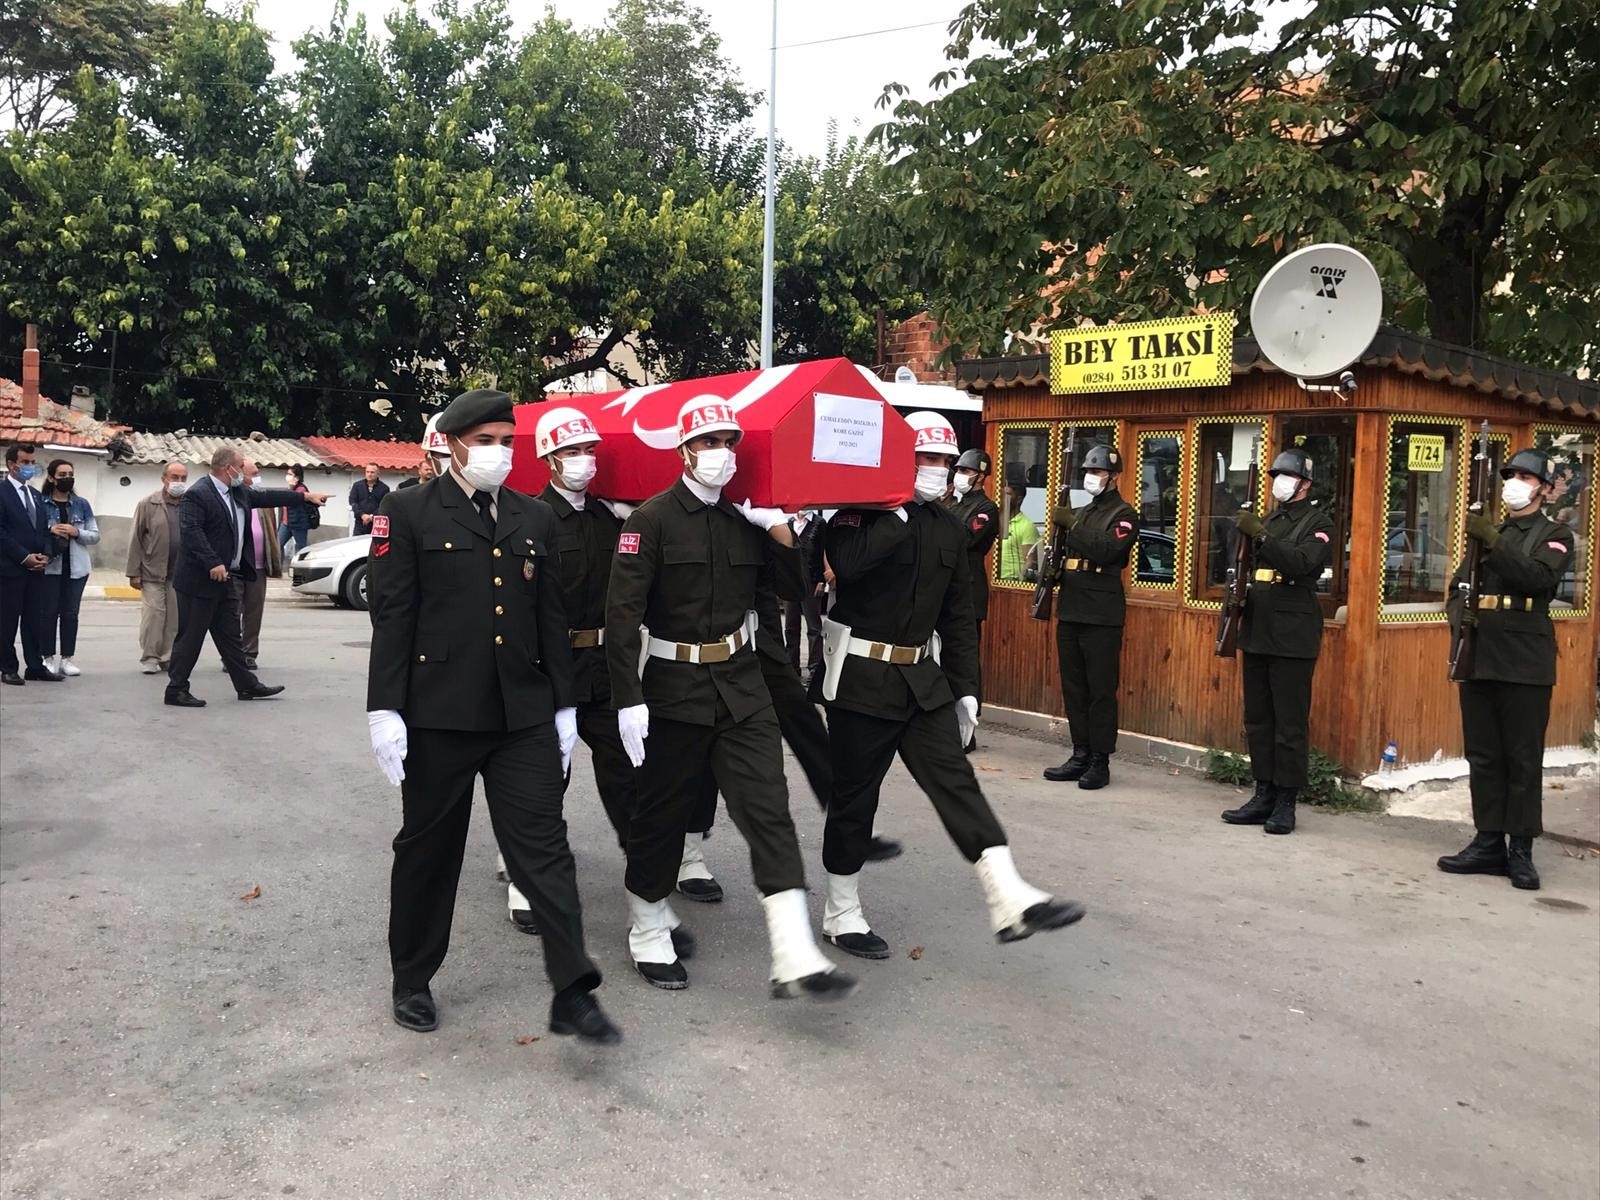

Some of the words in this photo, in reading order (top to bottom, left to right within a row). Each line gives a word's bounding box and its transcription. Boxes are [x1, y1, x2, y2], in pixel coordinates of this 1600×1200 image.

[1310, 266, 1347, 277] arnix
[1064, 338, 1117, 365] BEY
[1128, 324, 1215, 361] TAKSİ
[1083, 372, 1114, 384] (0284)
[1121, 365, 1148, 381] 513
[1152, 363, 1167, 378] 31
[1173, 361, 1191, 377] 07
[1415, 445, 1439, 463] 7/24
